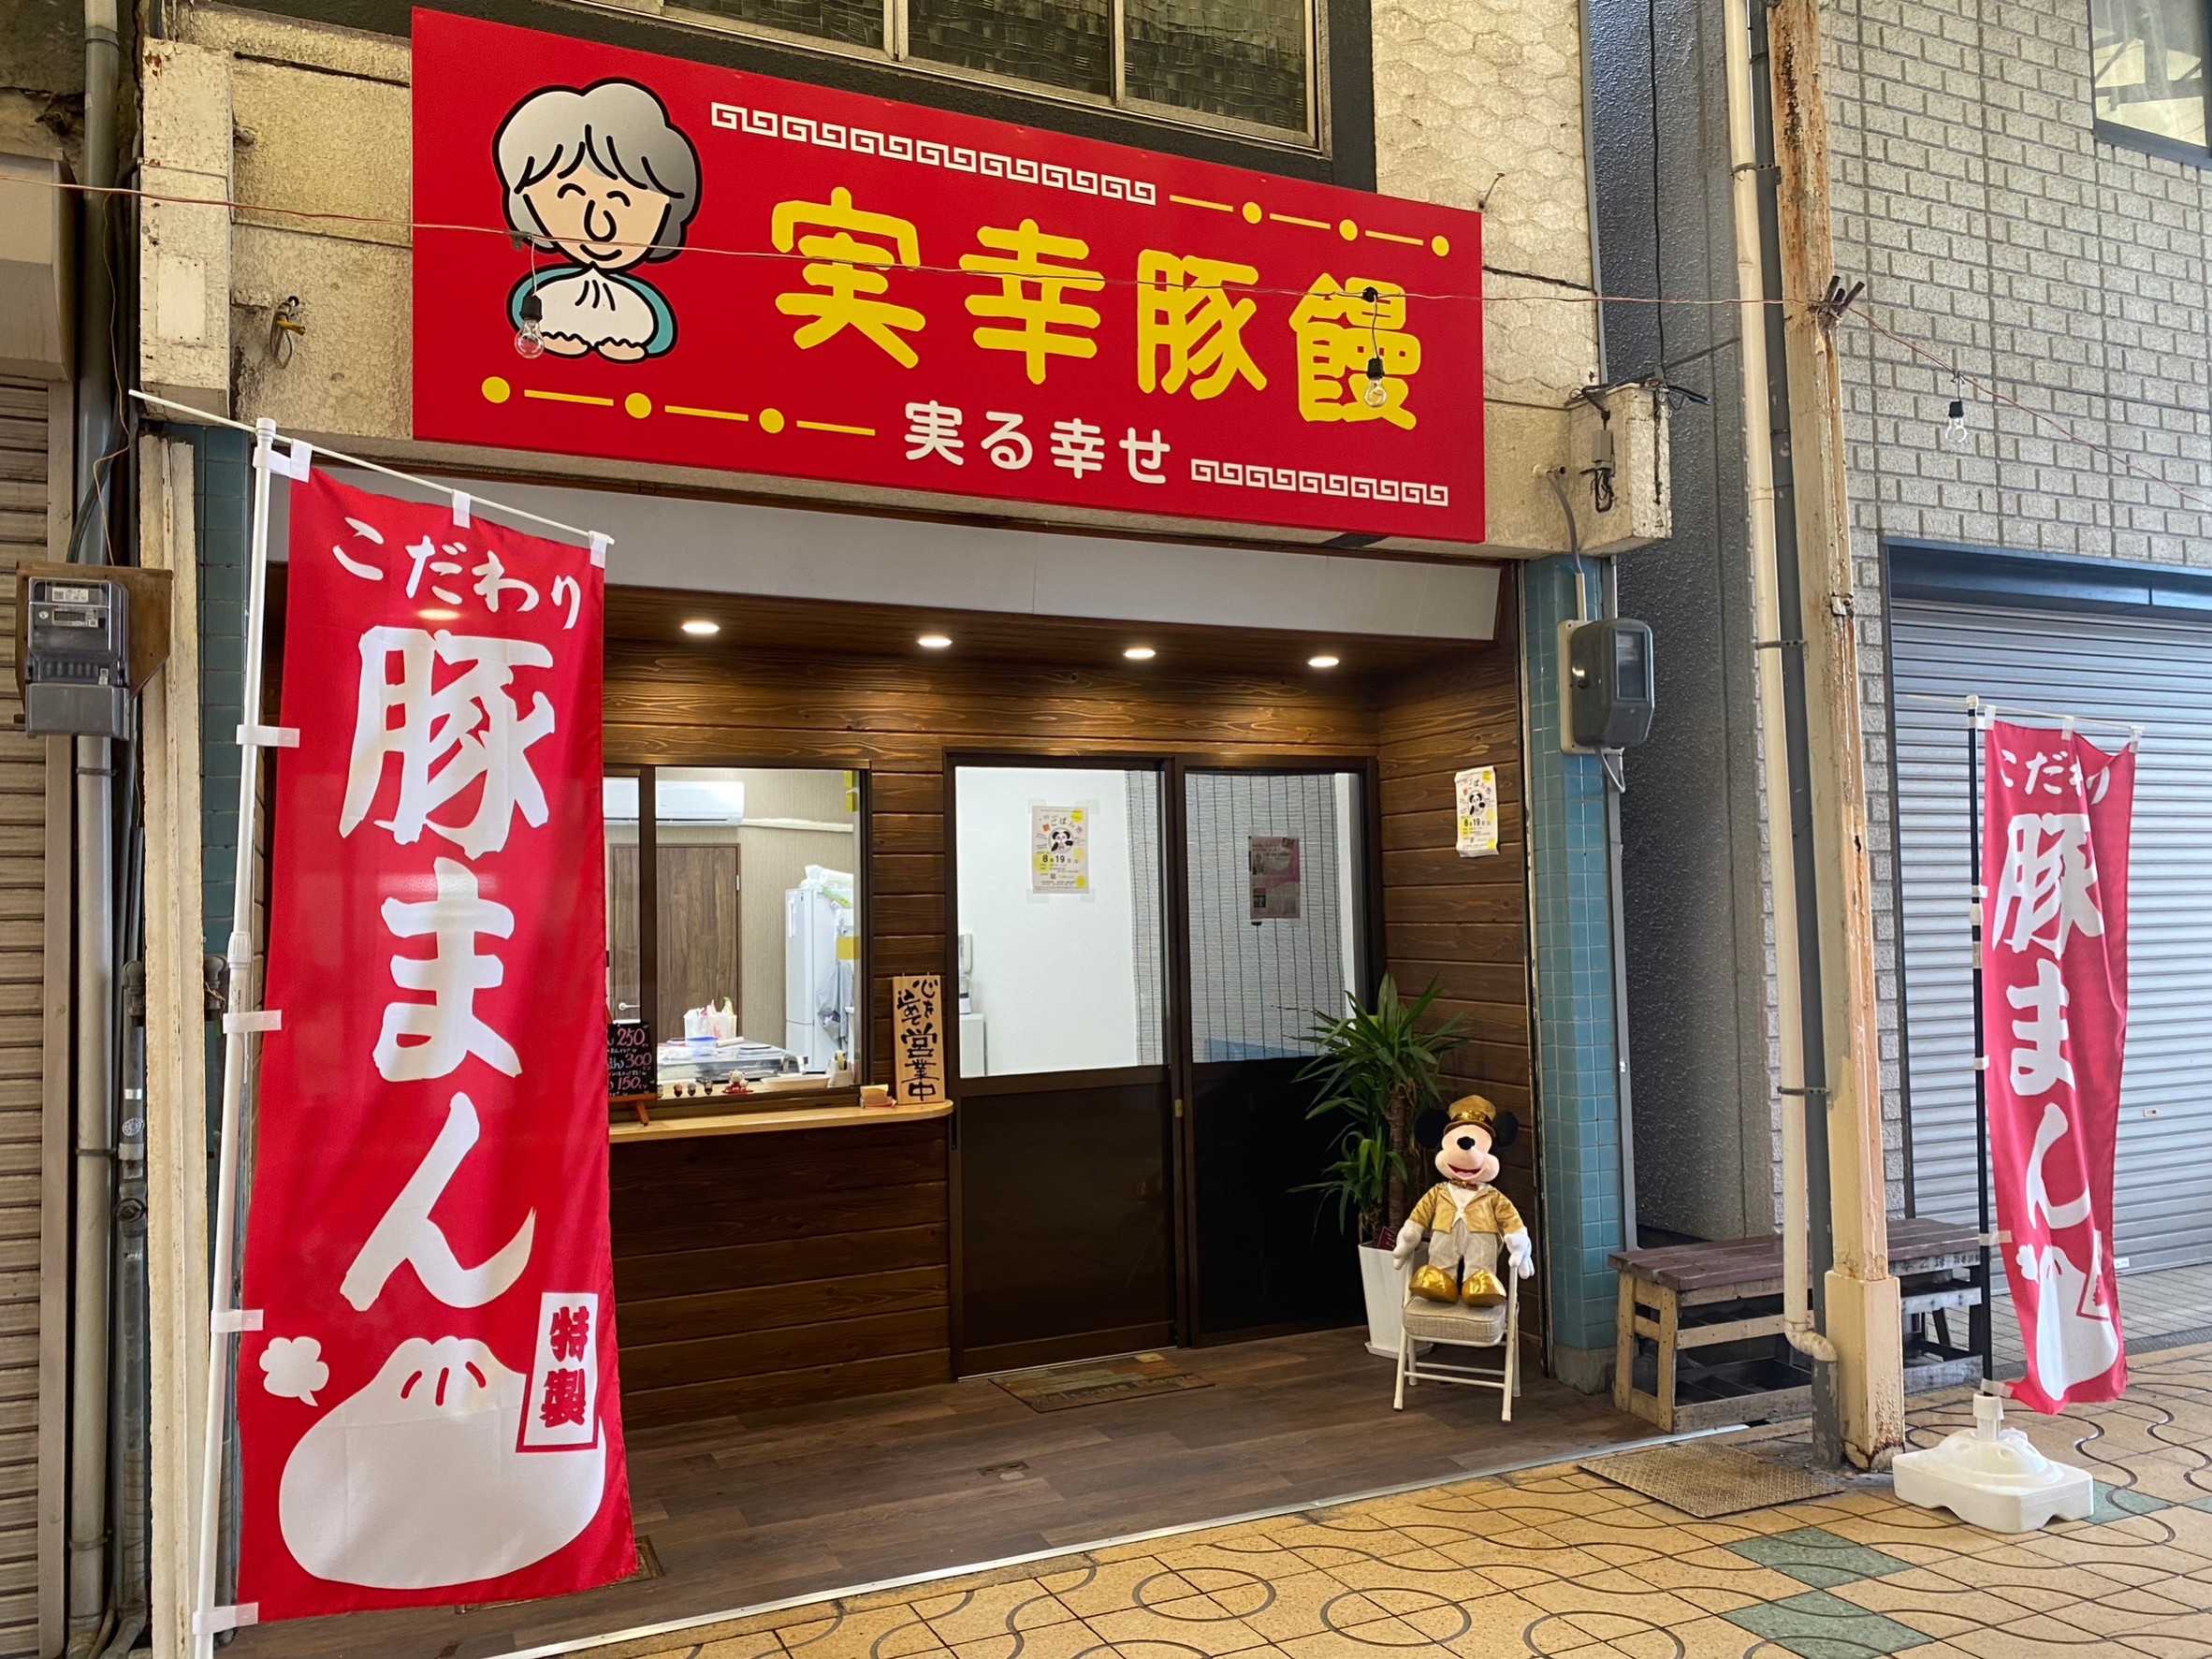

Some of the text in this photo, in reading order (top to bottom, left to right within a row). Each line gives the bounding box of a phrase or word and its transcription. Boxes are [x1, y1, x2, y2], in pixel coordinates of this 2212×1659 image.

[771, 186, 1422, 430] 実幸豚饅
[905, 400, 1171, 485] 実る幸せ
[332, 517, 582, 631] こだわり
[340, 626, 556, 1312] 豚まん
[896, 988, 923, 1026] 込めて
[912, 979, 939, 1019] 心を
[617, 1027, 646, 1047] 250
[625, 1052, 653, 1069] 300
[1991, 812, 2104, 1230] 豚まん
[618, 1076, 642, 1091] 150
[900, 1023, 940, 1101] 営業中
[541, 1306, 589, 1429] 特製
